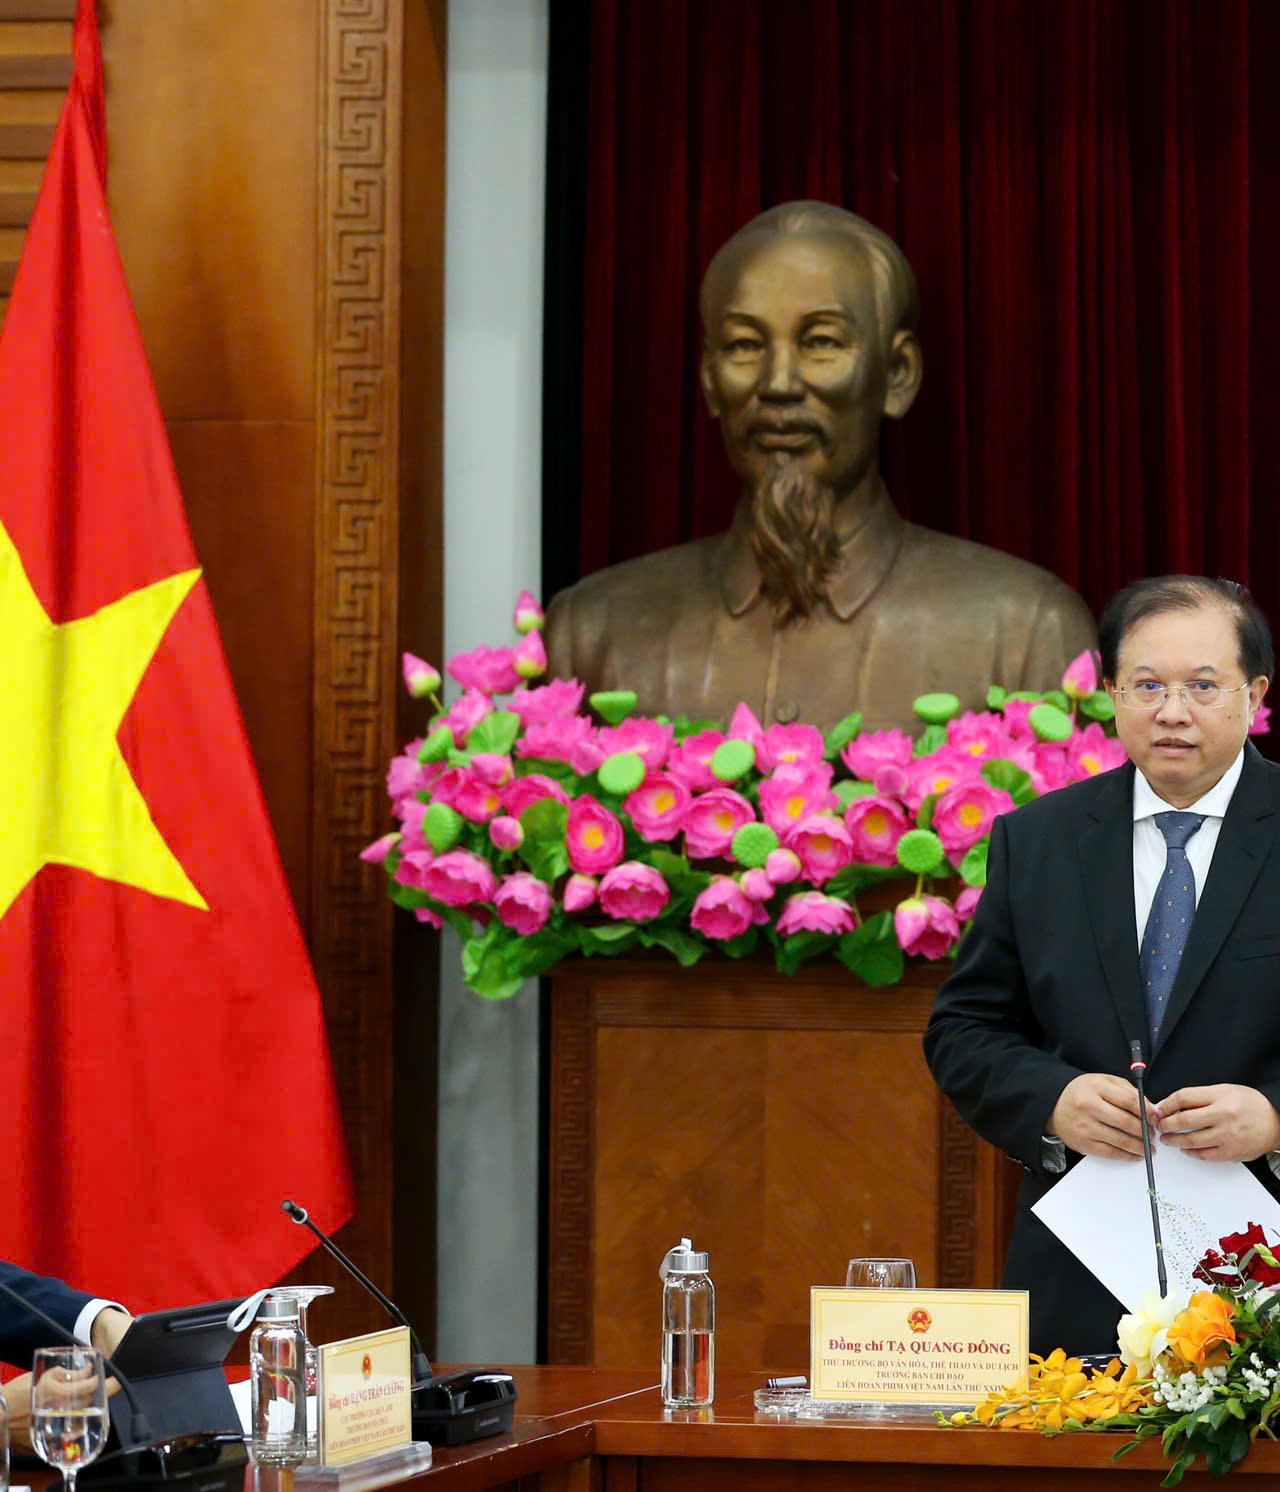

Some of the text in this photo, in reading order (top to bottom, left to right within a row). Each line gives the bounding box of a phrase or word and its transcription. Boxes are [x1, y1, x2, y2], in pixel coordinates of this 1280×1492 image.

[829, 1336, 1011, 1354] Đồng chí TẠ QUANG ĐÔNG
[949, 1361, 971, 1370] THAO
[985, 1362, 997, 1370] DU
[912, 1372, 928, 1380] BAN
[857, 1381, 881, 1390] HOAN
[883, 1382, 904, 1390] PHIM
[925, 1383, 945, 1391] NAM
